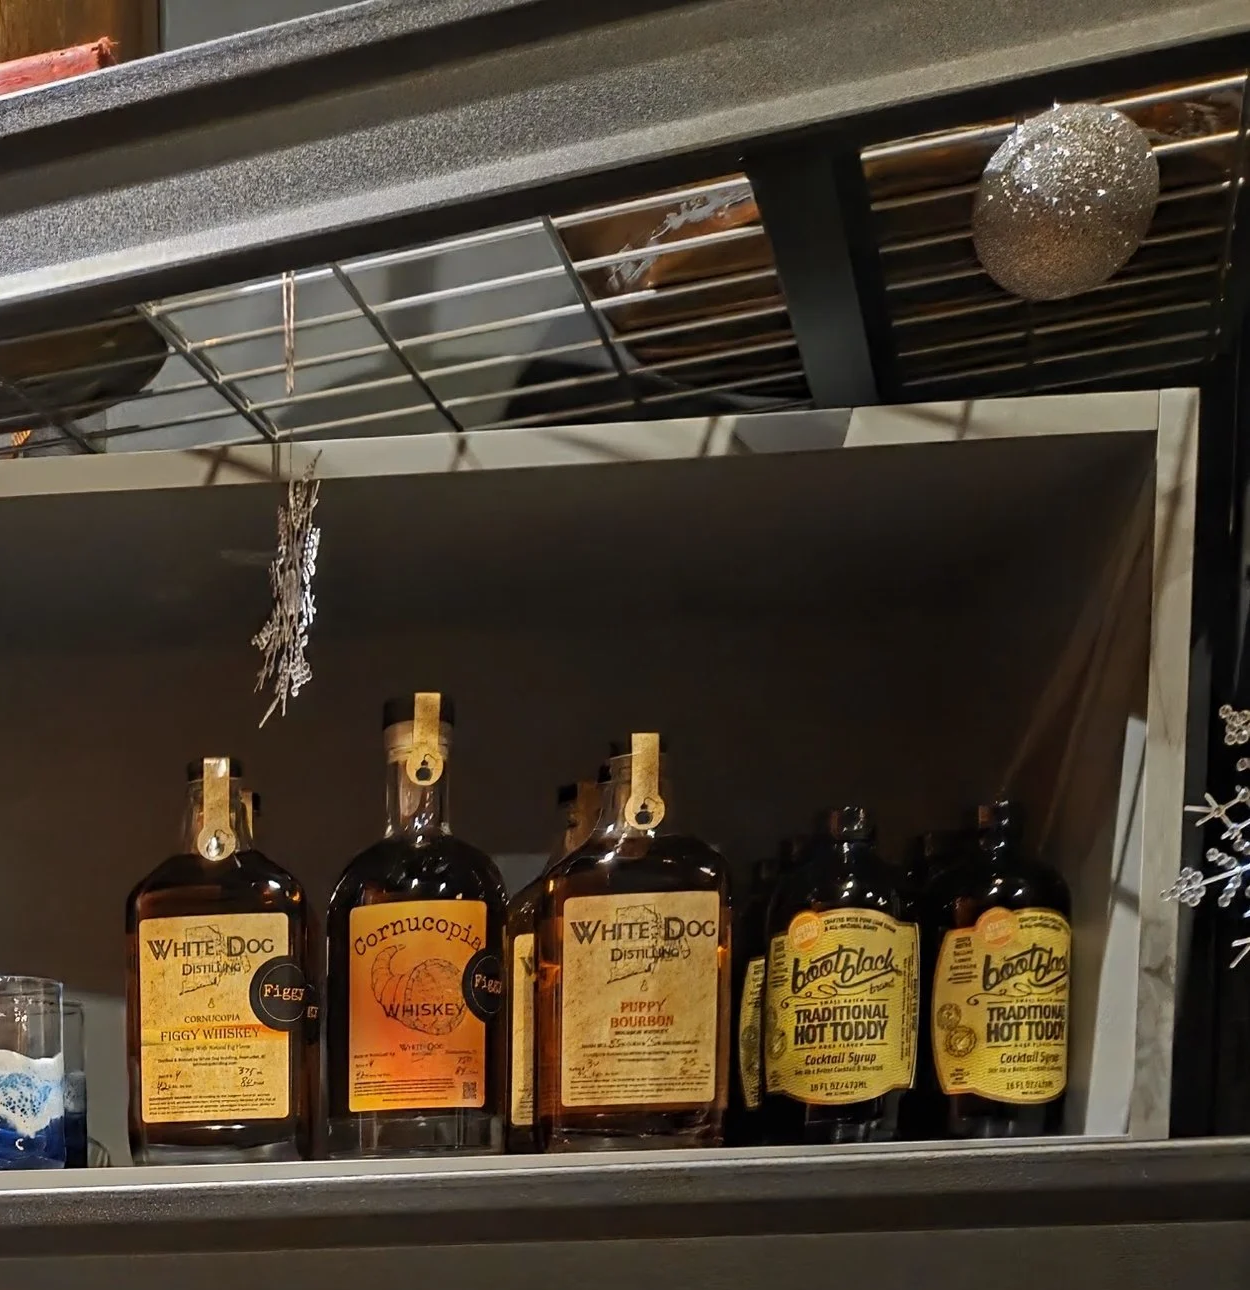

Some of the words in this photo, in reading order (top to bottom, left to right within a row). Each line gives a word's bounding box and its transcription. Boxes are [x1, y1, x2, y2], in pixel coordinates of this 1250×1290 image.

[354, 916, 483, 956] Cornucopia
[569, 919, 650, 945] WHITE
[663, 916, 716, 941] DOG
[147, 938, 214, 961] WHITE
[226, 936, 274, 957] DOG
[610, 948, 680, 962] DISTILLING
[182, 962, 241, 976] DISTILLING
[791, 944, 901, 995] bootblack
[982, 943, 1068, 991] bootblac
[263, 984, 305, 1001] Figgy
[382, 1003, 465, 1018] WHISKEY
[620, 998, 666, 1013] PUPPY
[795, 1003, 889, 1024] TRADITIONAL
[184, 1014, 240, 1024] CORNUCOPIA
[610, 1015, 674, 1029] BOURBON
[160, 1028, 201, 1042] FIGGY
[202, 1027, 260, 1040] WHISKEY
[794, 1022, 828, 1045] HOT
[829, 1020, 888, 1042] TODDY
[986, 1021, 1023, 1043] HOT
[805, 1052, 845, 1066] Cocktail
[848, 1052, 877, 1065] Syrup
[1000, 1051, 1040, 1064] Cocktail
